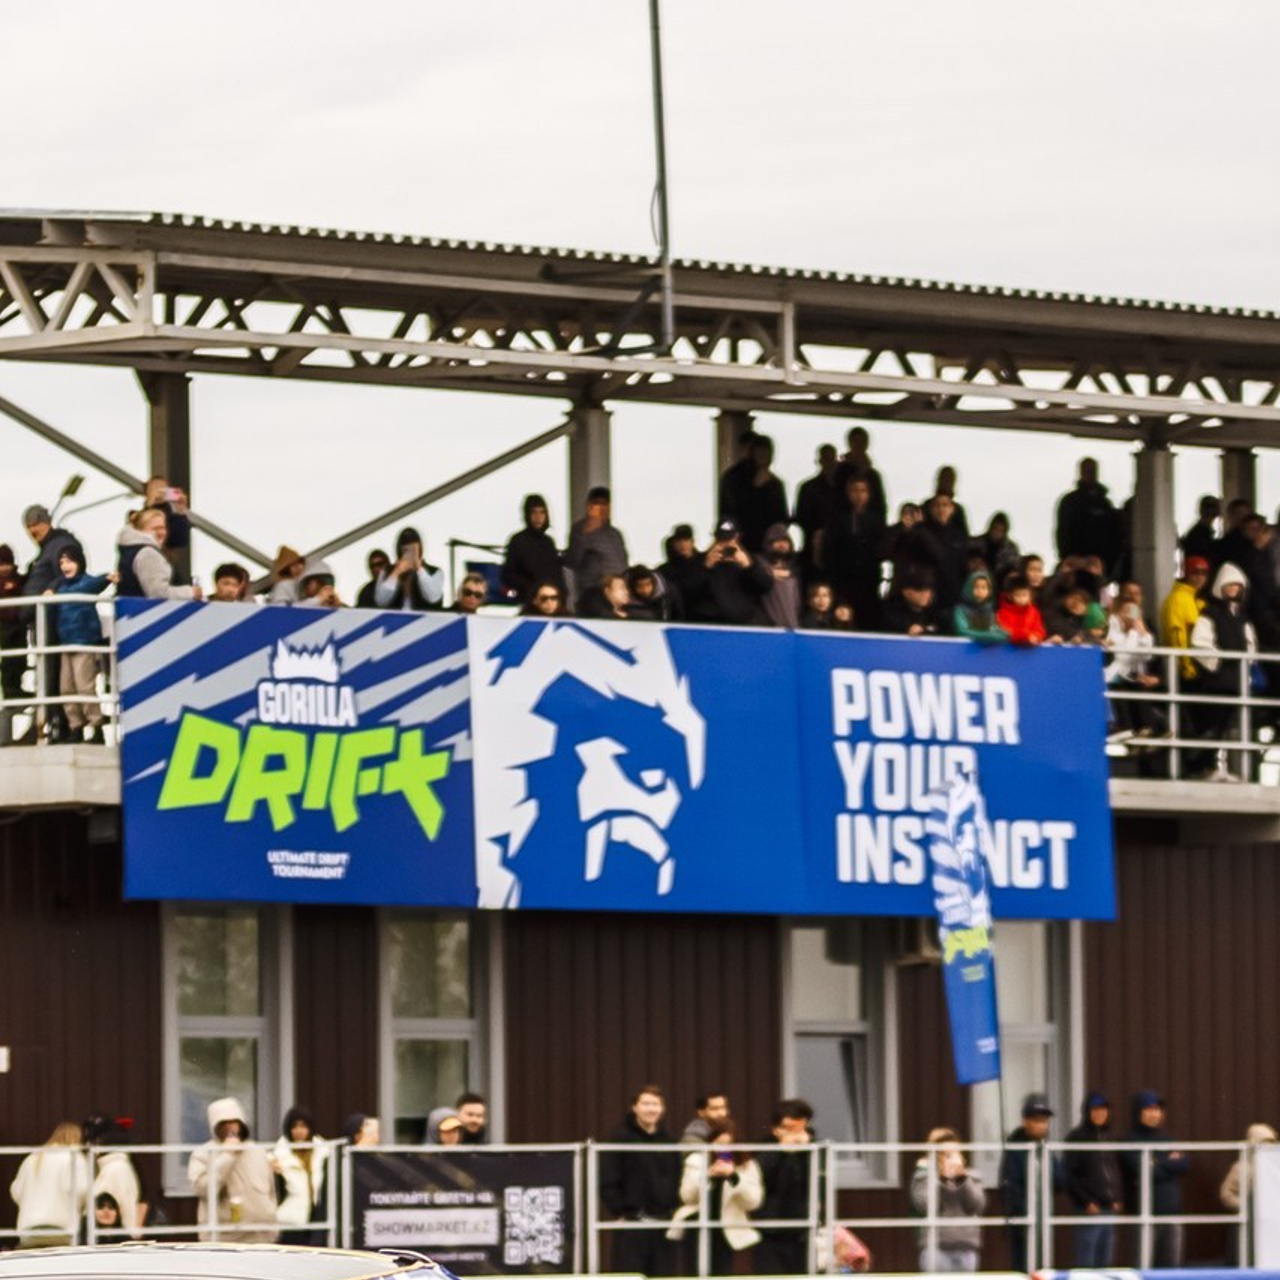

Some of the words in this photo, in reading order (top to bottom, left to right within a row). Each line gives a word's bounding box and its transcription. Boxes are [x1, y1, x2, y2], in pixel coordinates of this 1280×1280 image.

[258, 681, 358, 727] GORILLA
[831, 667, 1019, 744] POWER
[267, 850, 317, 864] ULTIMATE
[318, 852, 350, 866] DRIFT
[272, 864, 345, 879] TOURNAMENT
[836, 813, 1076, 889] INSNCT
